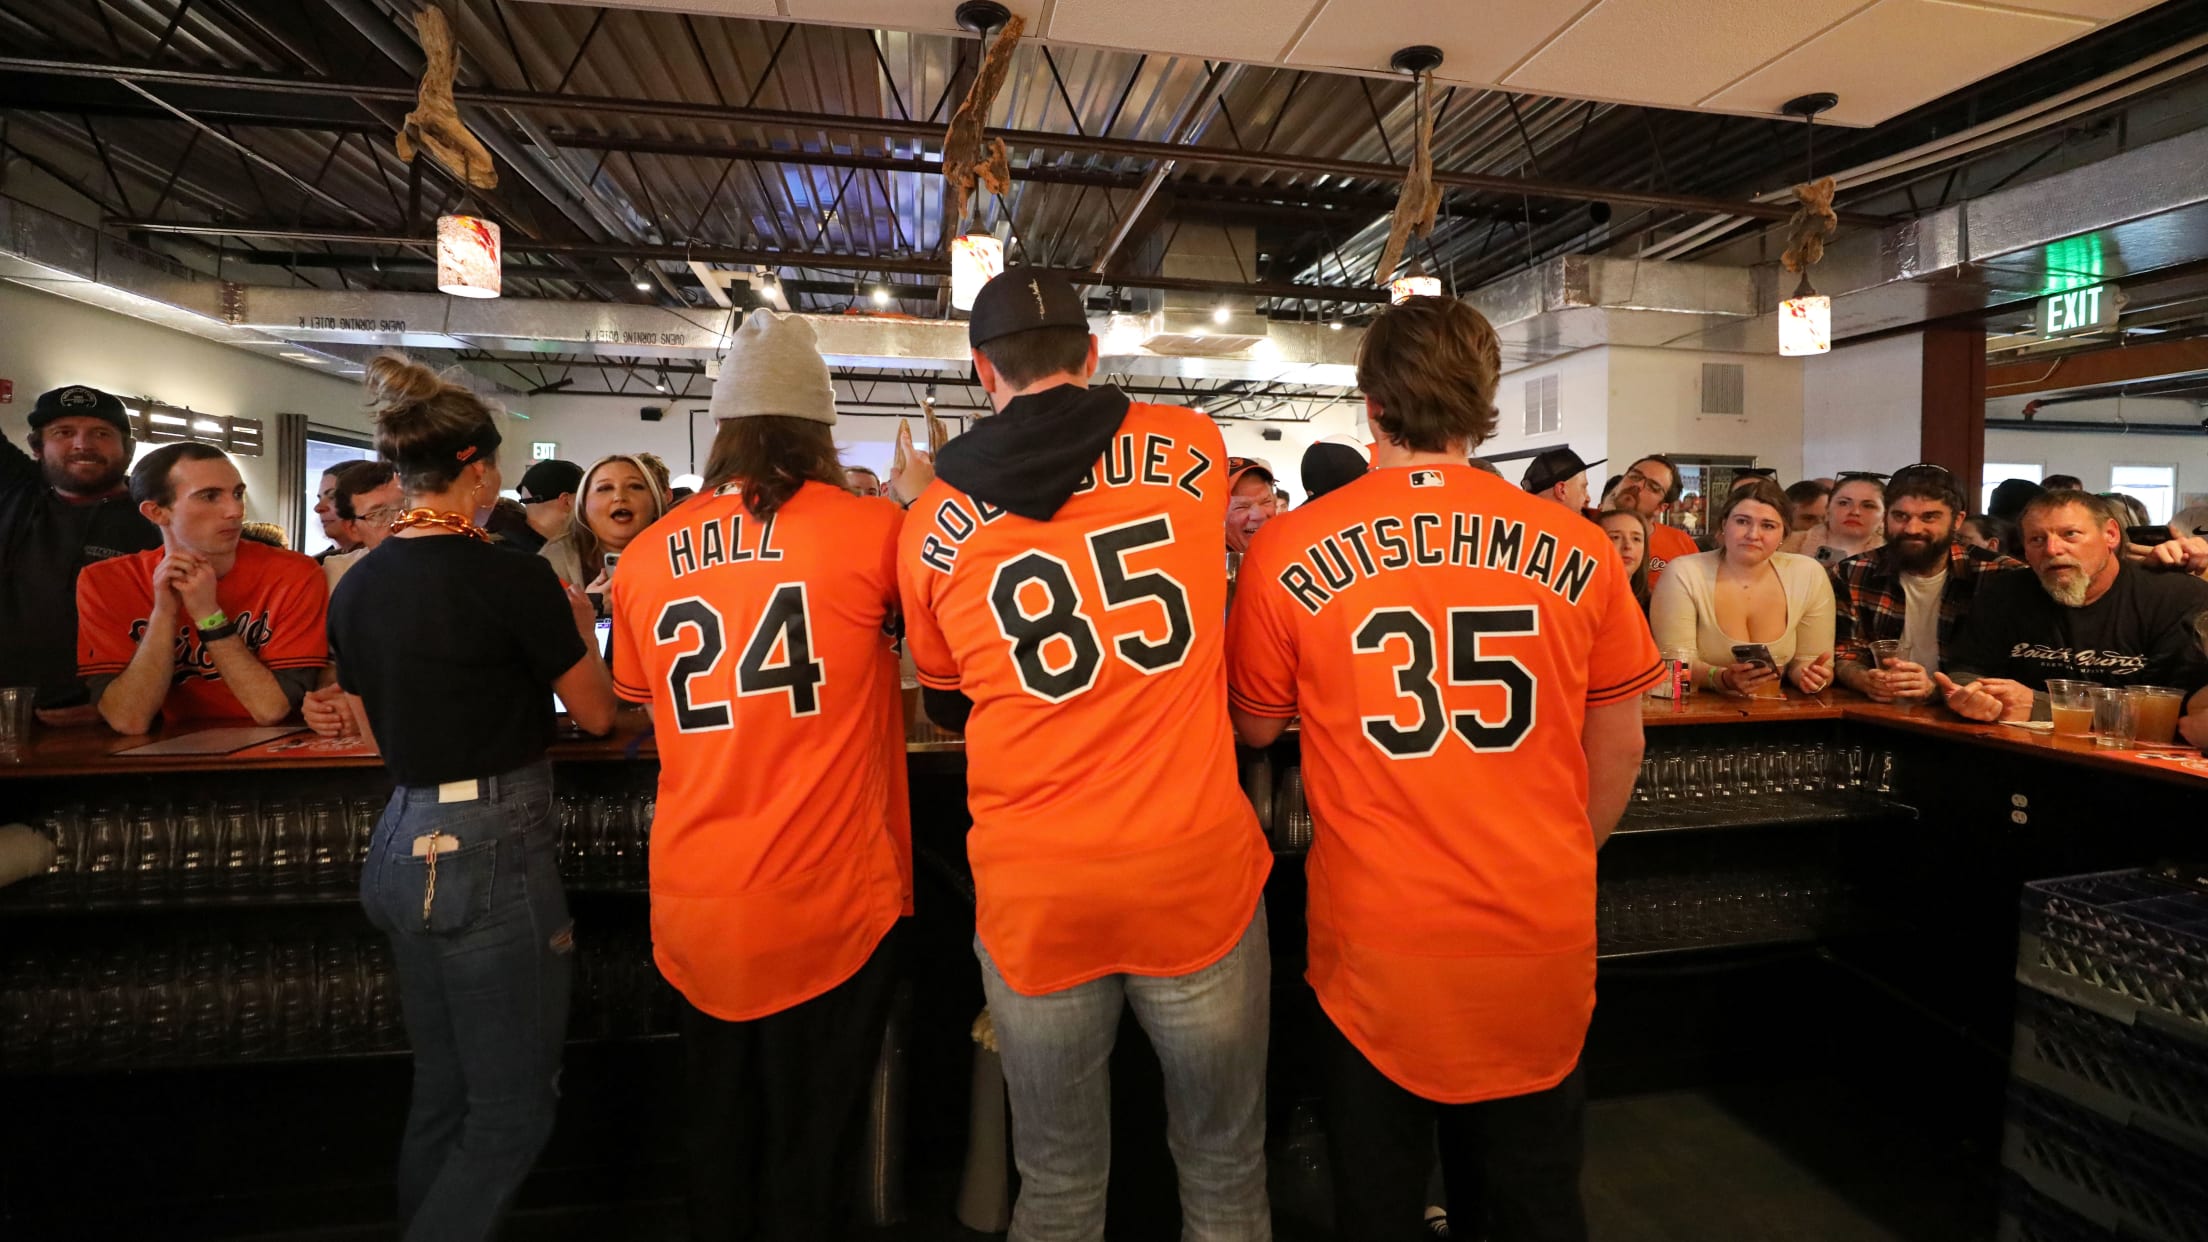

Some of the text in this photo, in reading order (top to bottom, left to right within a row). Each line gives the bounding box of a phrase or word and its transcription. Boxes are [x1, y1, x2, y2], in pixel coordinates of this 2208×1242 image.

[340, 317, 376, 331] CORNING
[380, 319, 406, 333] OWENS
[2047, 286, 2104, 333] EXIT
[622, 330, 657, 345] CORNING
[660, 332, 685, 346] OWENS
[533, 442, 556, 460] EXIT
[921, 433, 1212, 575] ROUEZ
[667, 513, 784, 579] HALL
[1277, 512, 1598, 616] RUTSCHMAN
[987, 512, 1196, 704] 85
[653, 581, 827, 734] 24
[2010, 642, 2073, 663] South
[2075, 650, 2147, 675] County
[1352, 604, 1539, 760] 35
